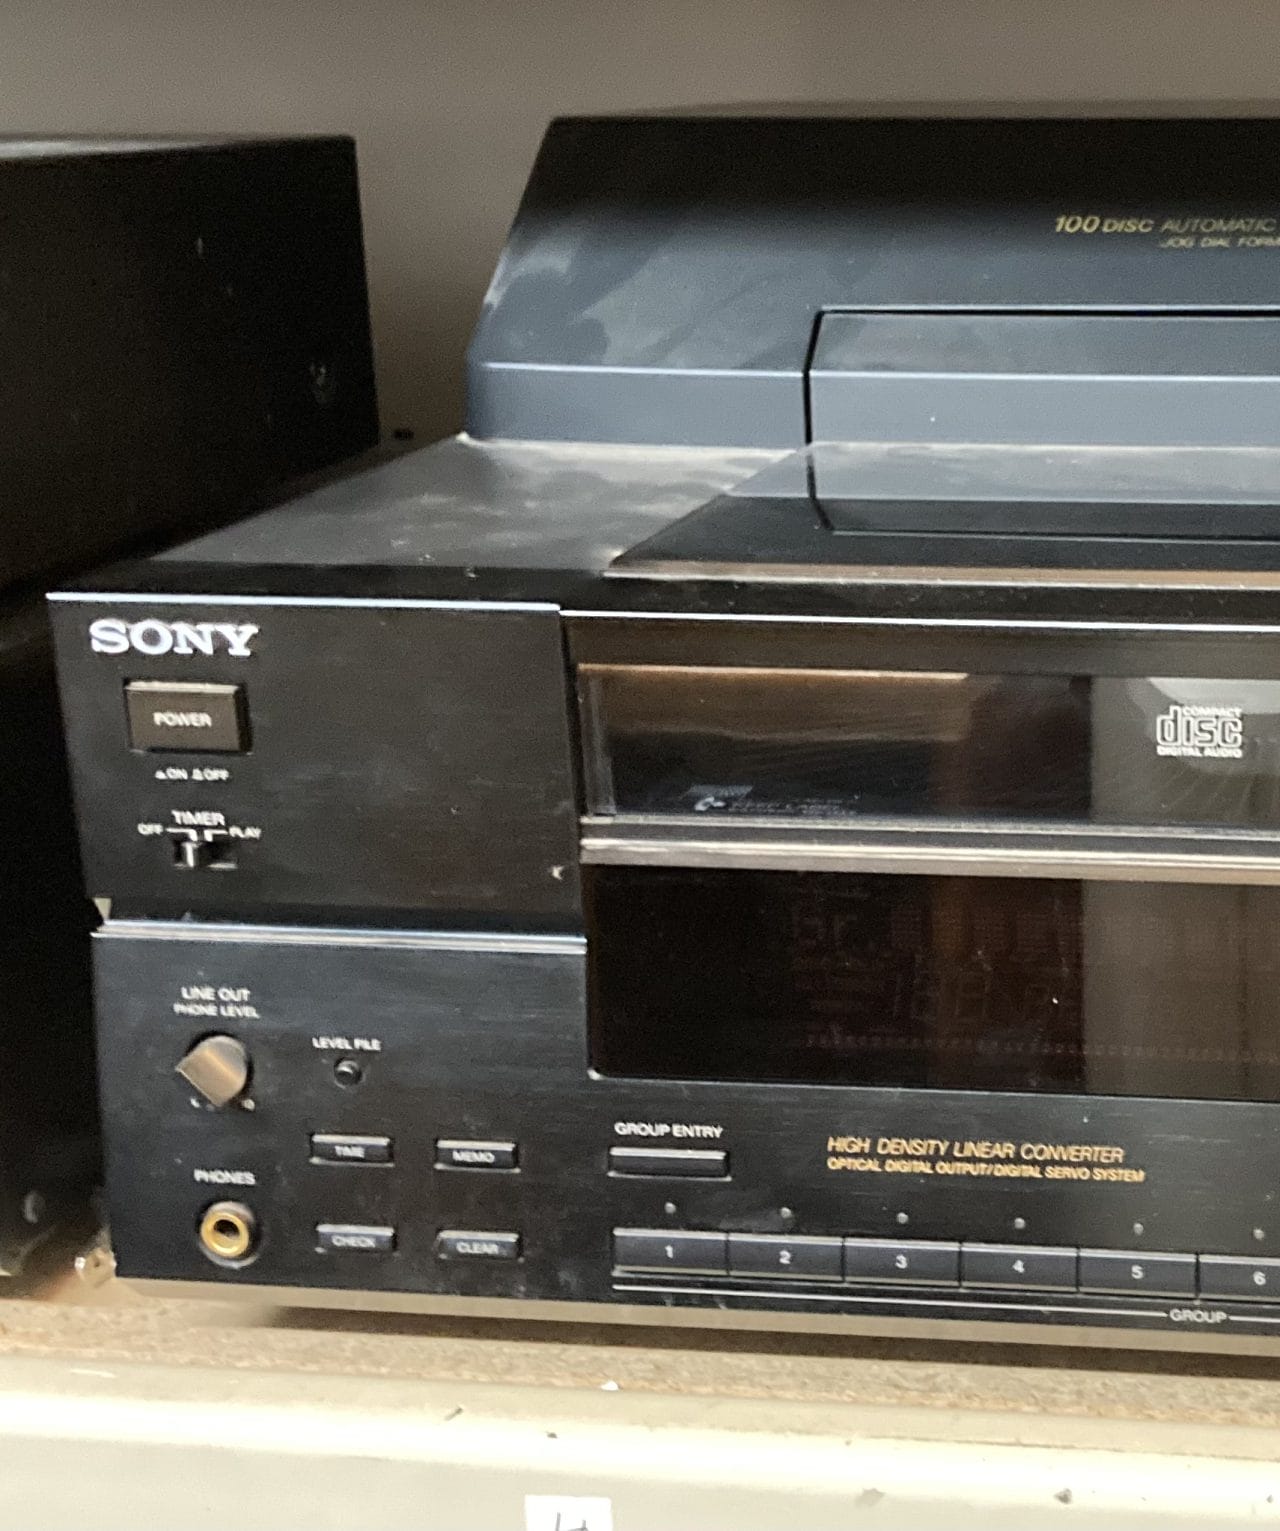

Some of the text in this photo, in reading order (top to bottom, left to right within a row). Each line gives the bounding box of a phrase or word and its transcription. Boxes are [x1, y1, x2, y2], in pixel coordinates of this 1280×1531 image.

[1055, 215, 1100, 233] 100
[1102, 218, 1153, 233] DISC
[1160, 218, 1276, 233] AUTOMATIC
[88, 618, 259, 656] SONY
[1182, 705, 1242, 717] COMPACT
[153, 712, 212, 727] POWER
[1156, 705, 1243, 748] disc
[172, 810, 226, 826] TIMER
[138, 823, 163, 835] OFF
[229, 826, 262, 838] PLAY
[181, 986, 250, 1002] LINE OUT
[173, 1003, 260, 1019] PHONE LEVEL
[312, 1037, 382, 1051] LEVEL FILE
[614, 1122, 724, 1138] GROUP ENTRY
[334, 1145, 366, 1158] TIME
[452, 1150, 496, 1163] MEMO
[827, 1136, 1126, 1164] HIGH DENSITY LINEAR CONVERTER
[193, 1169, 256, 1185] PHONES
[826, 1157, 883, 1173] OPTICAL
[884, 1160, 935, 1175] DIGITAL
[1045, 1166, 1091, 1181] SERVO
[1092, 1168, 1146, 1184] SYSTEM
[331, 1235, 376, 1248] CHECK
[456, 1241, 501, 1254] CLEAR
[779, 1250, 791, 1265] 2
[896, 1255, 908, 1270] 3
[1012, 1260, 1025, 1275] 4
[1131, 1265, 1144, 1280] 5
[1253, 1271, 1266, 1286] 6
[1169, 1308, 1228, 1325] GROUP
